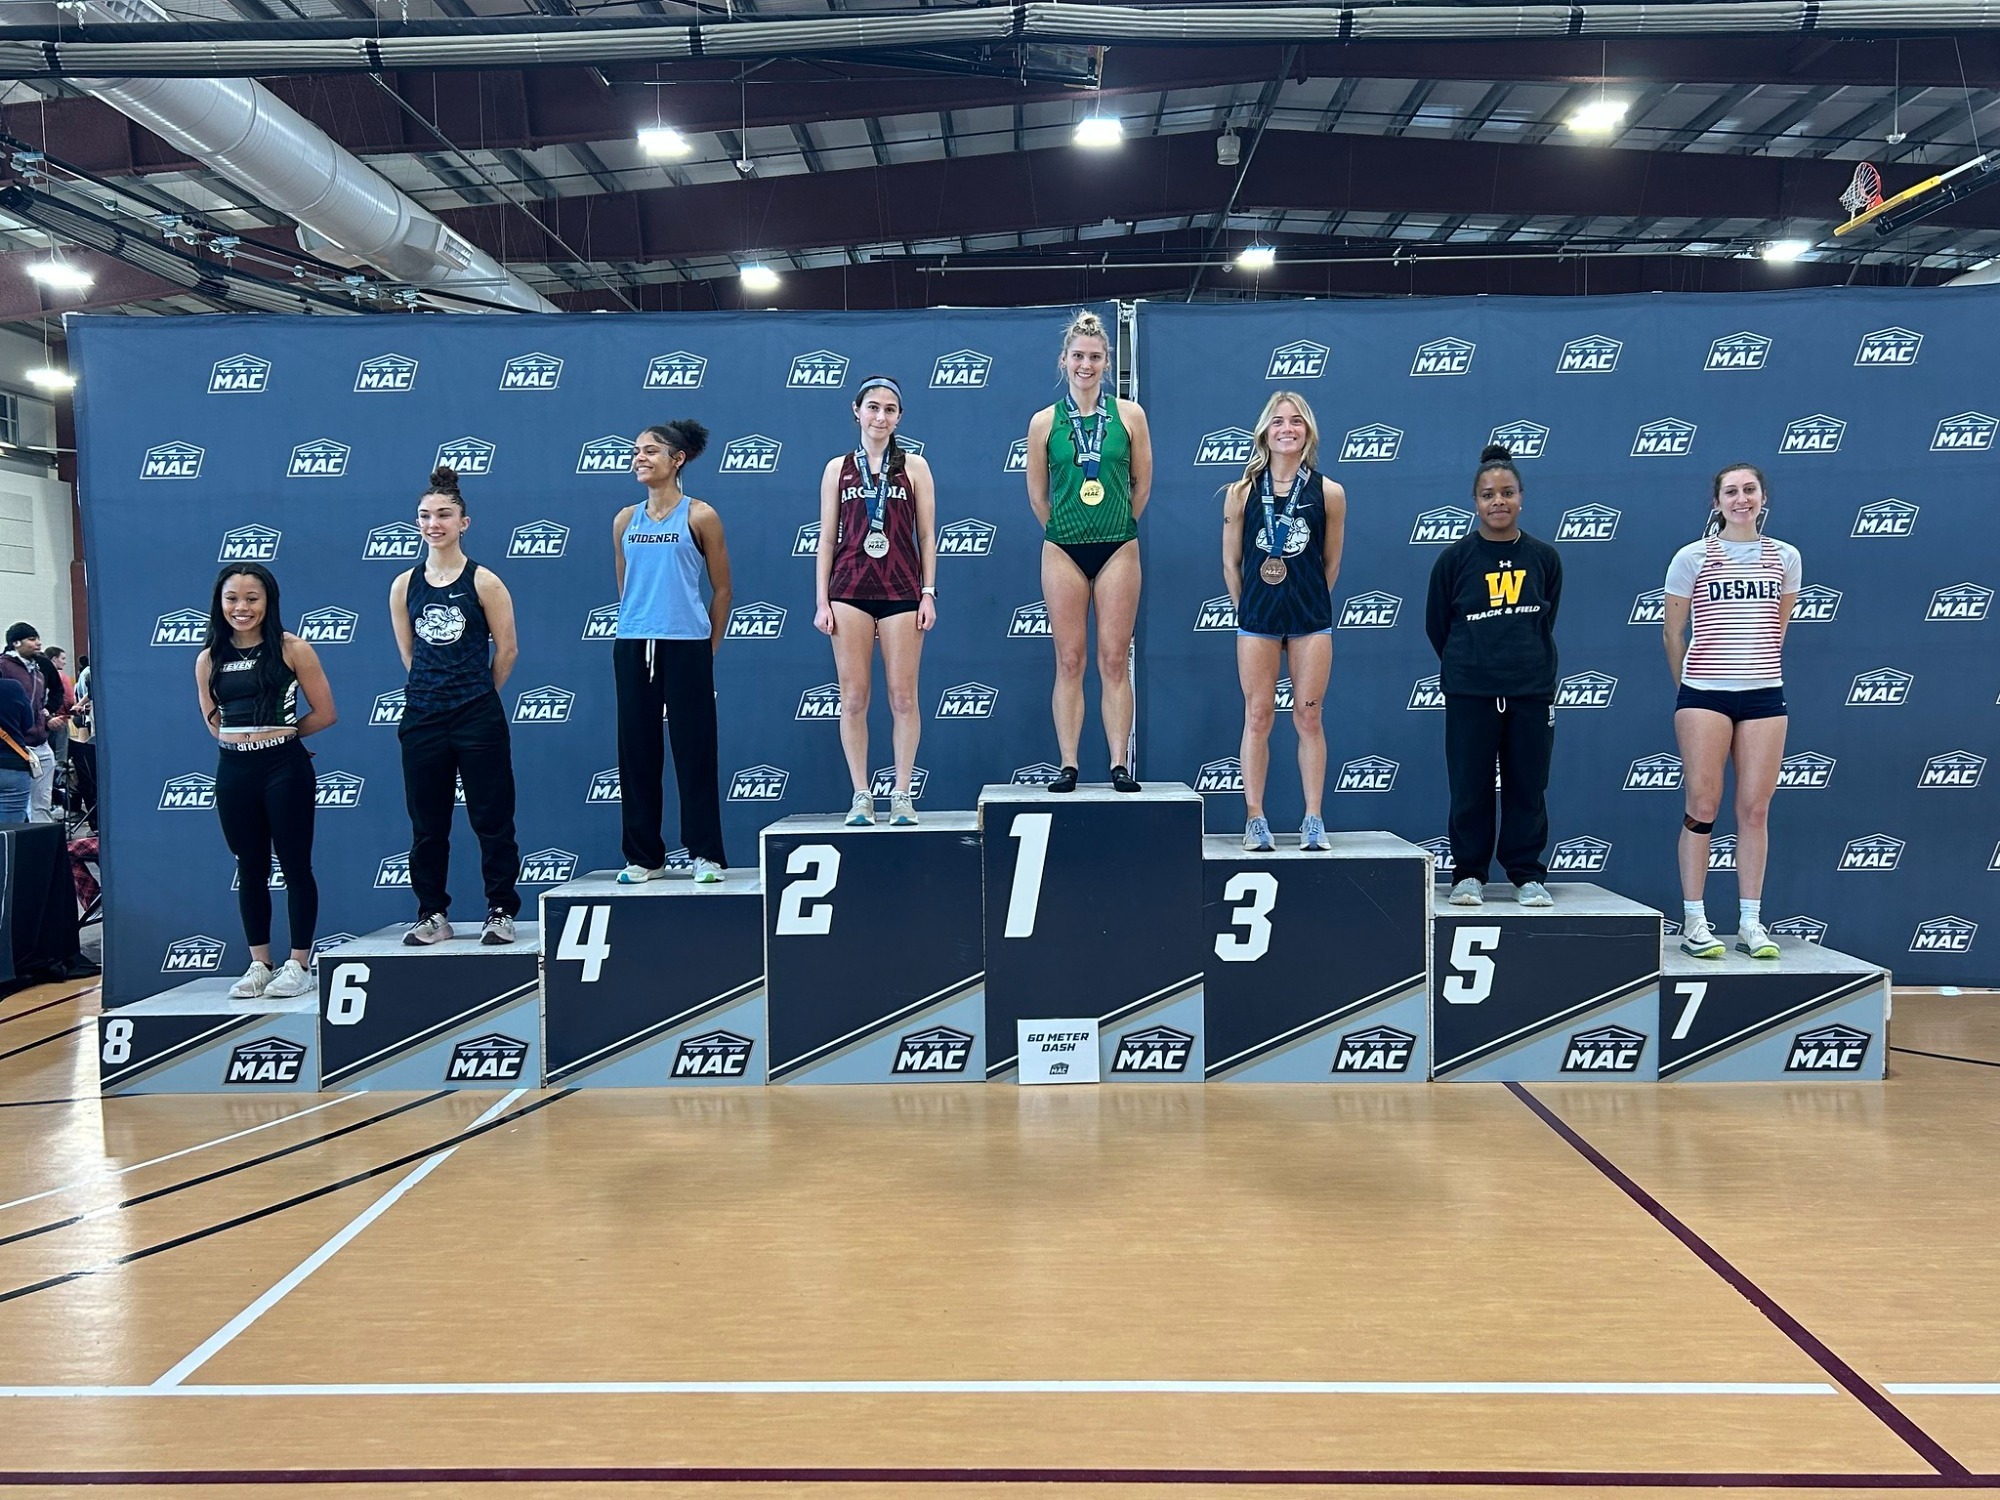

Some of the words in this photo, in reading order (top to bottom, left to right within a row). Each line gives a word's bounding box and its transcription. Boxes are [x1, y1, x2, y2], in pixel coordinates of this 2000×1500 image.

[1710, 351, 1763, 366] MAC
[1861, 347, 1914, 361] MAC
[1272, 360, 1321, 374] MAC
[1417, 356, 1467, 372] MAC
[1563, 354, 1614, 369] MAC
[214, 374, 264, 389] MAC
[360, 373, 410, 388] MAC
[506, 372, 556, 386] MAC
[650, 371, 699, 384] MAC
[792, 370, 841, 384] MAC
[936, 370, 984, 384] MAC
[1637, 438, 1688, 452] MAC
[1785, 434, 1837, 449] MAC
[1936, 432, 1990, 446] MAC
[1200, 446, 1250, 461] MAC
[1345, 443, 1395, 457] MAC
[146, 461, 196, 475] MAC
[293, 458, 342, 473] MAC
[439, 457, 488, 471] MAC
[582, 455, 631, 469] MAC
[726, 454, 774, 468] MAC
[1562, 523, 1612, 537] MAC
[1858, 519, 1910, 532] MAC
[628, 533, 680, 544] WIDENER
[1416, 526, 1466, 540] MAC
[224, 544, 273, 558] MAC
[368, 542, 418, 555] MAC
[513, 540, 562, 554] MAC
[940, 538, 988, 552] MAC
[1485, 569, 1526, 607] W
[1466, 608, 1503, 621] TRACK
[1505, 607, 1513, 615] &
[1515, 605, 1541, 614] FIELD
[1932, 603, 1984, 616] MAC
[1200, 613, 1239, 627] MA
[1344, 610, 1393, 624] MAC
[301, 626, 350, 640] MAC
[730, 621, 779, 634] MAC
[1013, 620, 1053, 633] MA
[157, 628, 206, 642] MAC
[1413, 692, 1446, 705] MA
[1558, 690, 1608, 704] MAC
[1852, 687, 1904, 701] MAC
[375, 707, 404, 721] MA
[518, 705, 567, 718] MAC
[942, 701, 990, 714] MAC
[1341, 775, 1390, 788] MAC
[1629, 772, 1680, 786] MAC
[1777, 771, 1827, 785] MAC
[1924, 770, 1977, 784] MAC
[592, 785, 622, 799] MA
[733, 784, 781, 797] MAC
[164, 792, 214, 806] MAC
[1553, 855, 1602, 868] MAC
[1844, 853, 1896, 866] MAC
[380, 870, 411, 884] MA
[522, 867, 570, 880] MAC
[1003, 813, 1053, 938] 1
[775, 844, 842, 935] 2
[1214, 872, 1279, 962] 3
[556, 905, 611, 982] 4
[1916, 935, 1968, 948] MAC
[167, 954, 218, 968] MAC
[1442, 926, 1501, 1005] 5
[326, 963, 371, 1025] 6
[1671, 982, 1708, 1039] 7
[102, 1019, 134, 1064] 8
[1027, 1033, 1045, 1042] 60
[1047, 1032, 1089, 1042] METER
[1041, 1043, 1076, 1052] DASH
[676, 1055, 744, 1074] MAC
[898, 1050, 965, 1070] MAC
[1117, 1050, 1185, 1069] MAC
[1338, 1050, 1407, 1069] MAC
[1566, 1050, 1637, 1068] MAC
[1790, 1049, 1862, 1068] MAC
[230, 1061, 298, 1080] MAC
[451, 1058, 520, 1077] MAC
